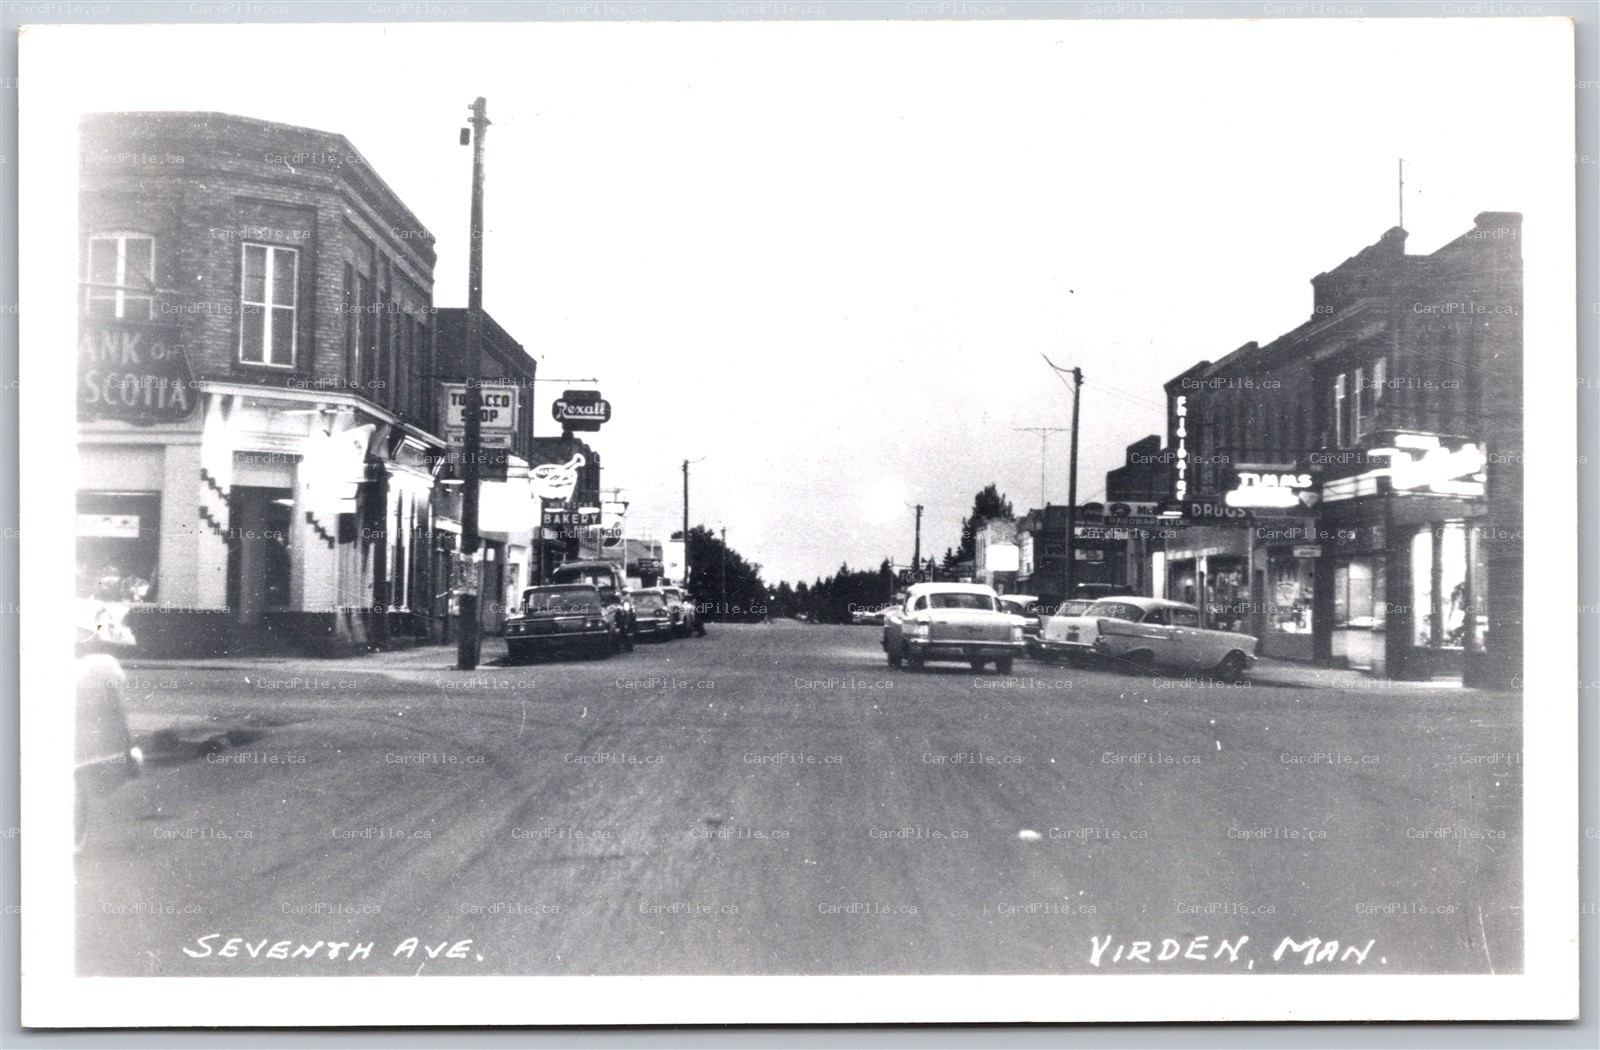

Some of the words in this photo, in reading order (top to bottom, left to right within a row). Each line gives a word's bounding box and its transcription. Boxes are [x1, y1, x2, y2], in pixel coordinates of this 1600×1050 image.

[84, 370, 187, 410] SCOTIA
[556, 401, 606, 419] Rexall
[1237, 473, 1313, 488] TIMMS
[1191, 503, 1246, 518] DRUGS
[543, 513, 598, 524] BAKERY
[1109, 517, 1160, 526] HARDWARE
